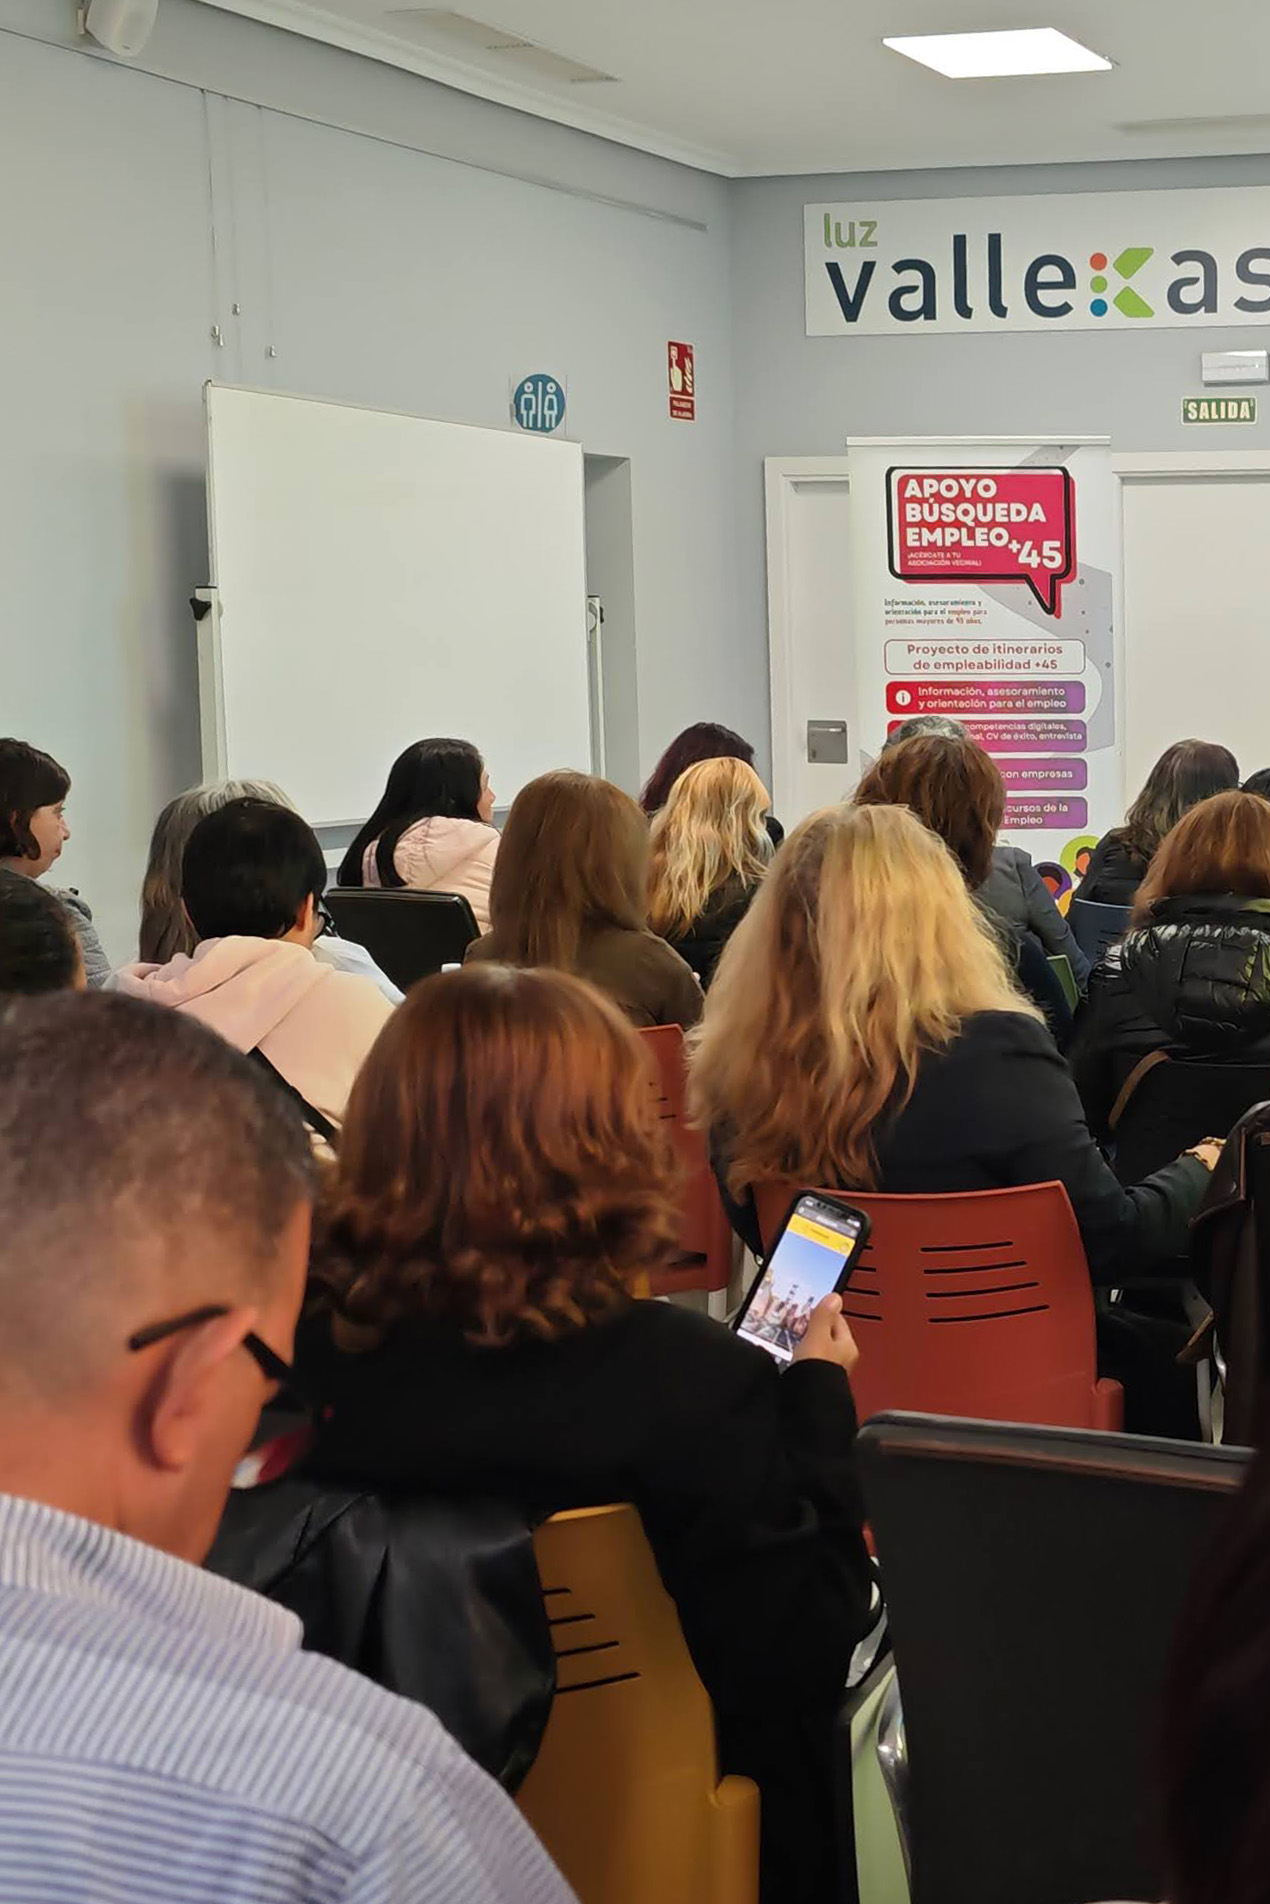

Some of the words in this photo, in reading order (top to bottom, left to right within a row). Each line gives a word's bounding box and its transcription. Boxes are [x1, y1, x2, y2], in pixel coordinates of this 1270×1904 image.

[824, 213, 878, 248] luz
[1188, 401, 1251, 420] SALIDA
[904, 478, 997, 499] APOYO
[905, 498, 1047, 527] BÚSQUEDA
[906, 526, 1009, 548] EMPLEO
[1008, 539, 1063, 569] +45
[907, 643, 969, 657] Proyecto
[972, 643, 989, 655] de
[993, 643, 1063, 655] itinerarios
[913, 659, 931, 671] de
[934, 658, 1031, 673] empleabilidad
[1034, 659, 1058, 671] +45
[918, 686, 986, 697] Información,
[987, 686, 1066, 696] asesoramiento
[918, 700, 925, 710] y
[926, 699, 987, 709] orientación
[989, 700, 1014, 711] para
[1015, 699, 1025, 708] el
[1027, 699, 1067, 710] empleo
[1028, 722, 1067, 733] digitales,
[986, 732, 999, 741] CV
[1001, 732, 1012, 740] de
[1013, 732, 1037, 742] éxito,
[1039, 732, 1083, 741] entrevista
[1021, 770, 1073, 780] empresas
[1043, 803, 1057, 812] de
[1059, 803, 1068, 812] la
[1004, 815, 1043, 826] Empleo
